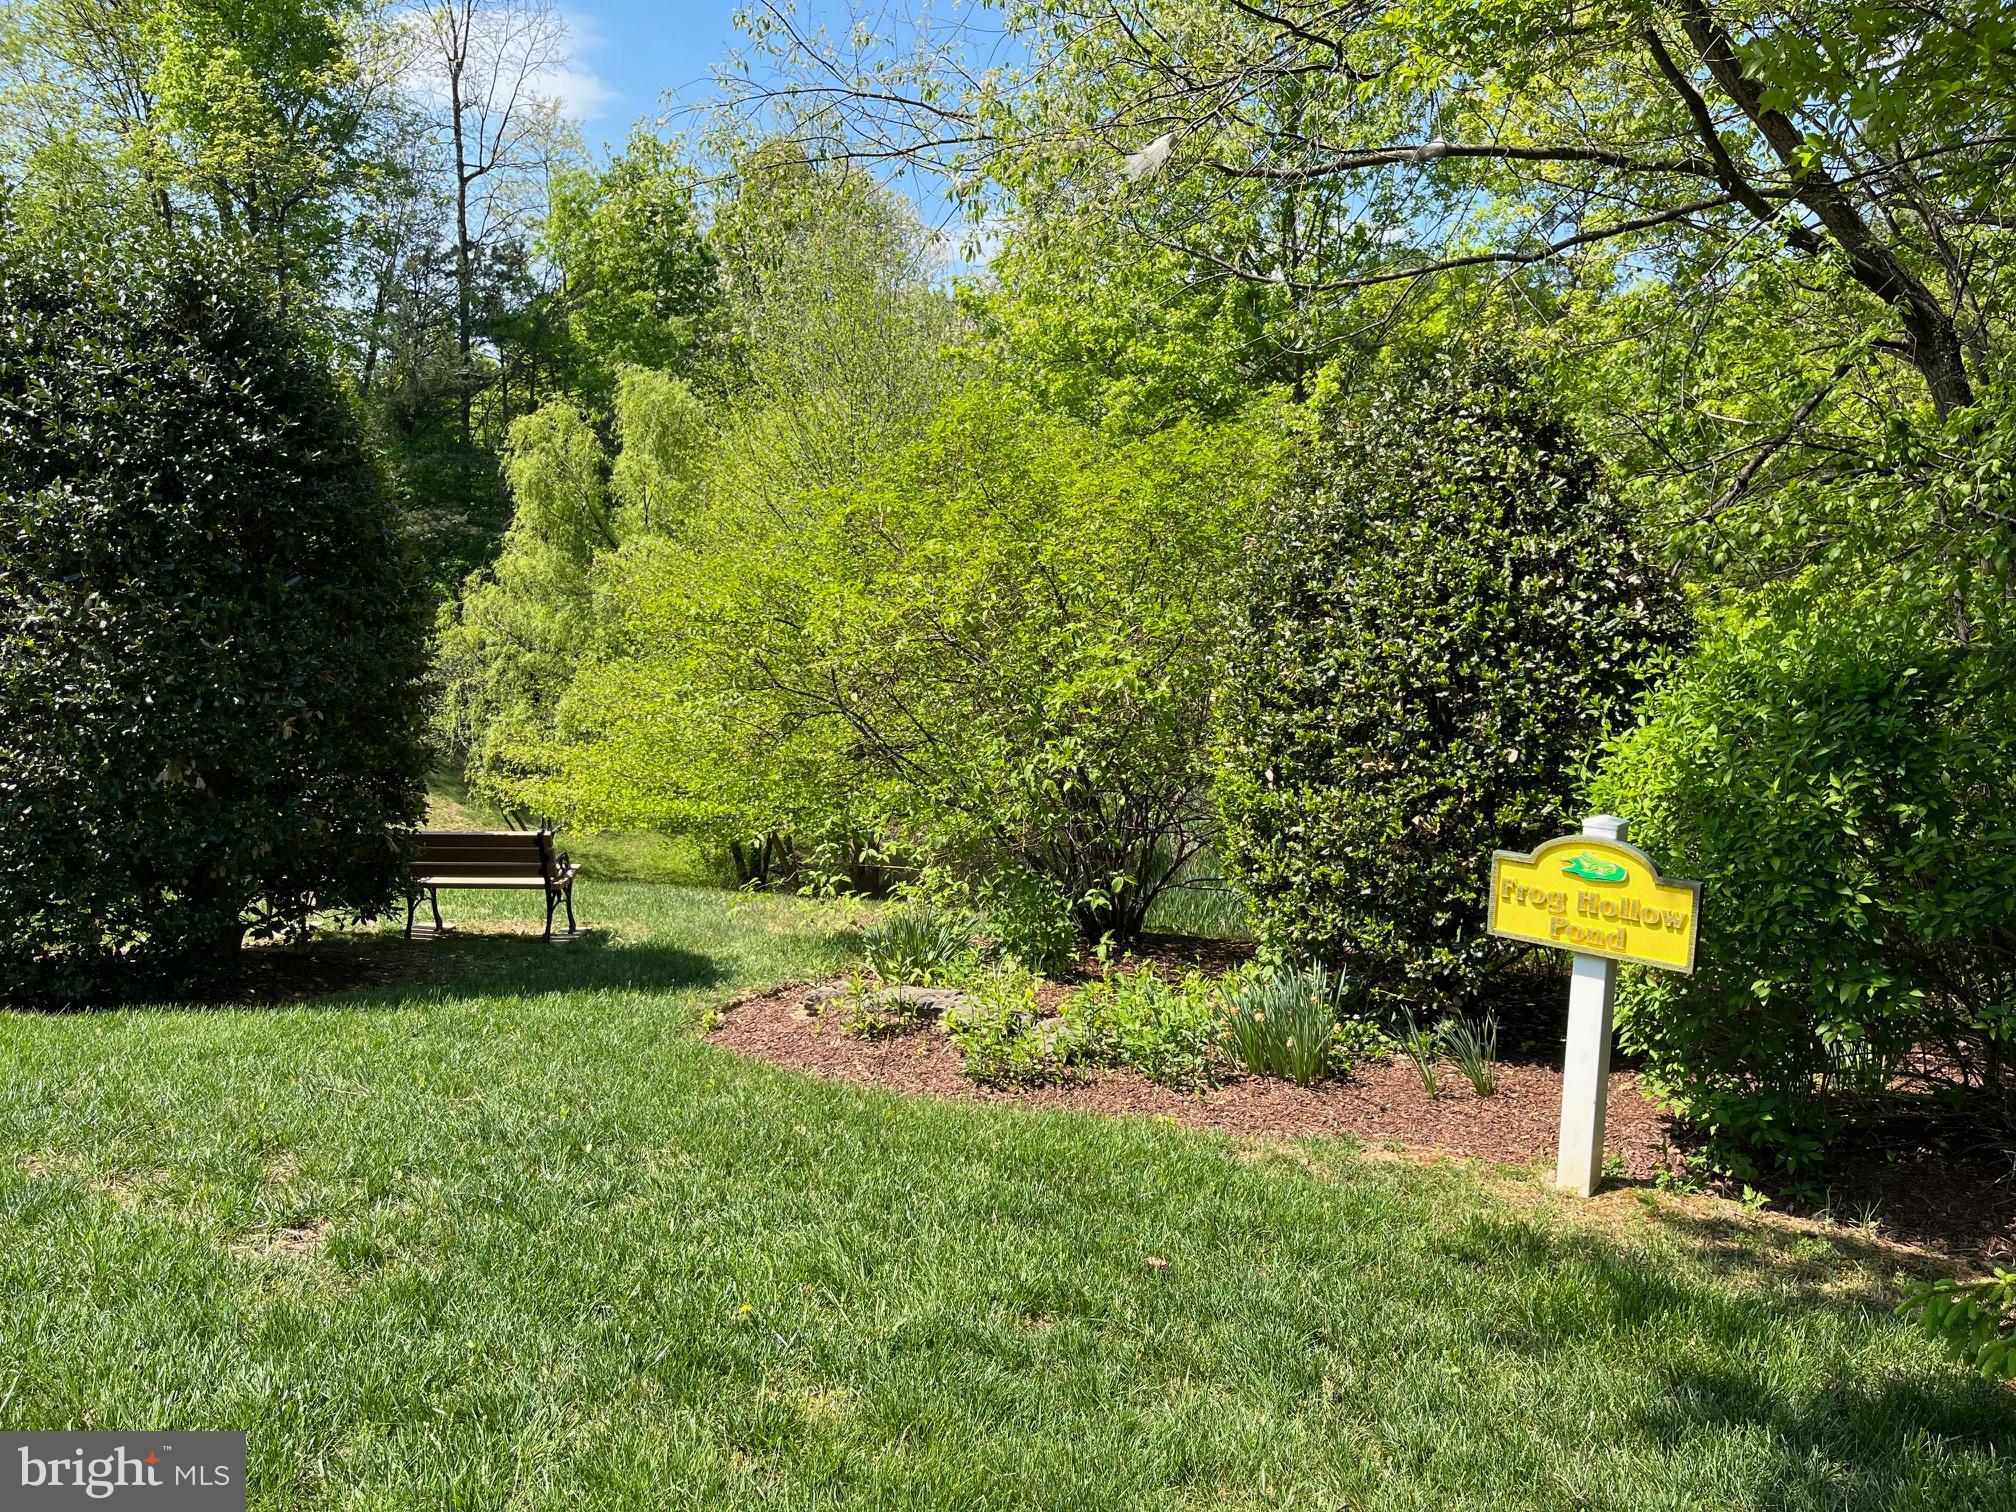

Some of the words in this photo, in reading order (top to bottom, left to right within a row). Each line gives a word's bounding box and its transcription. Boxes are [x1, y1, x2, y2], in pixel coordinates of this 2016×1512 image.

[1501, 877, 1567, 913] Frog
[1577, 890, 1688, 929] Hollow
[1550, 916, 1626, 949] Pond
